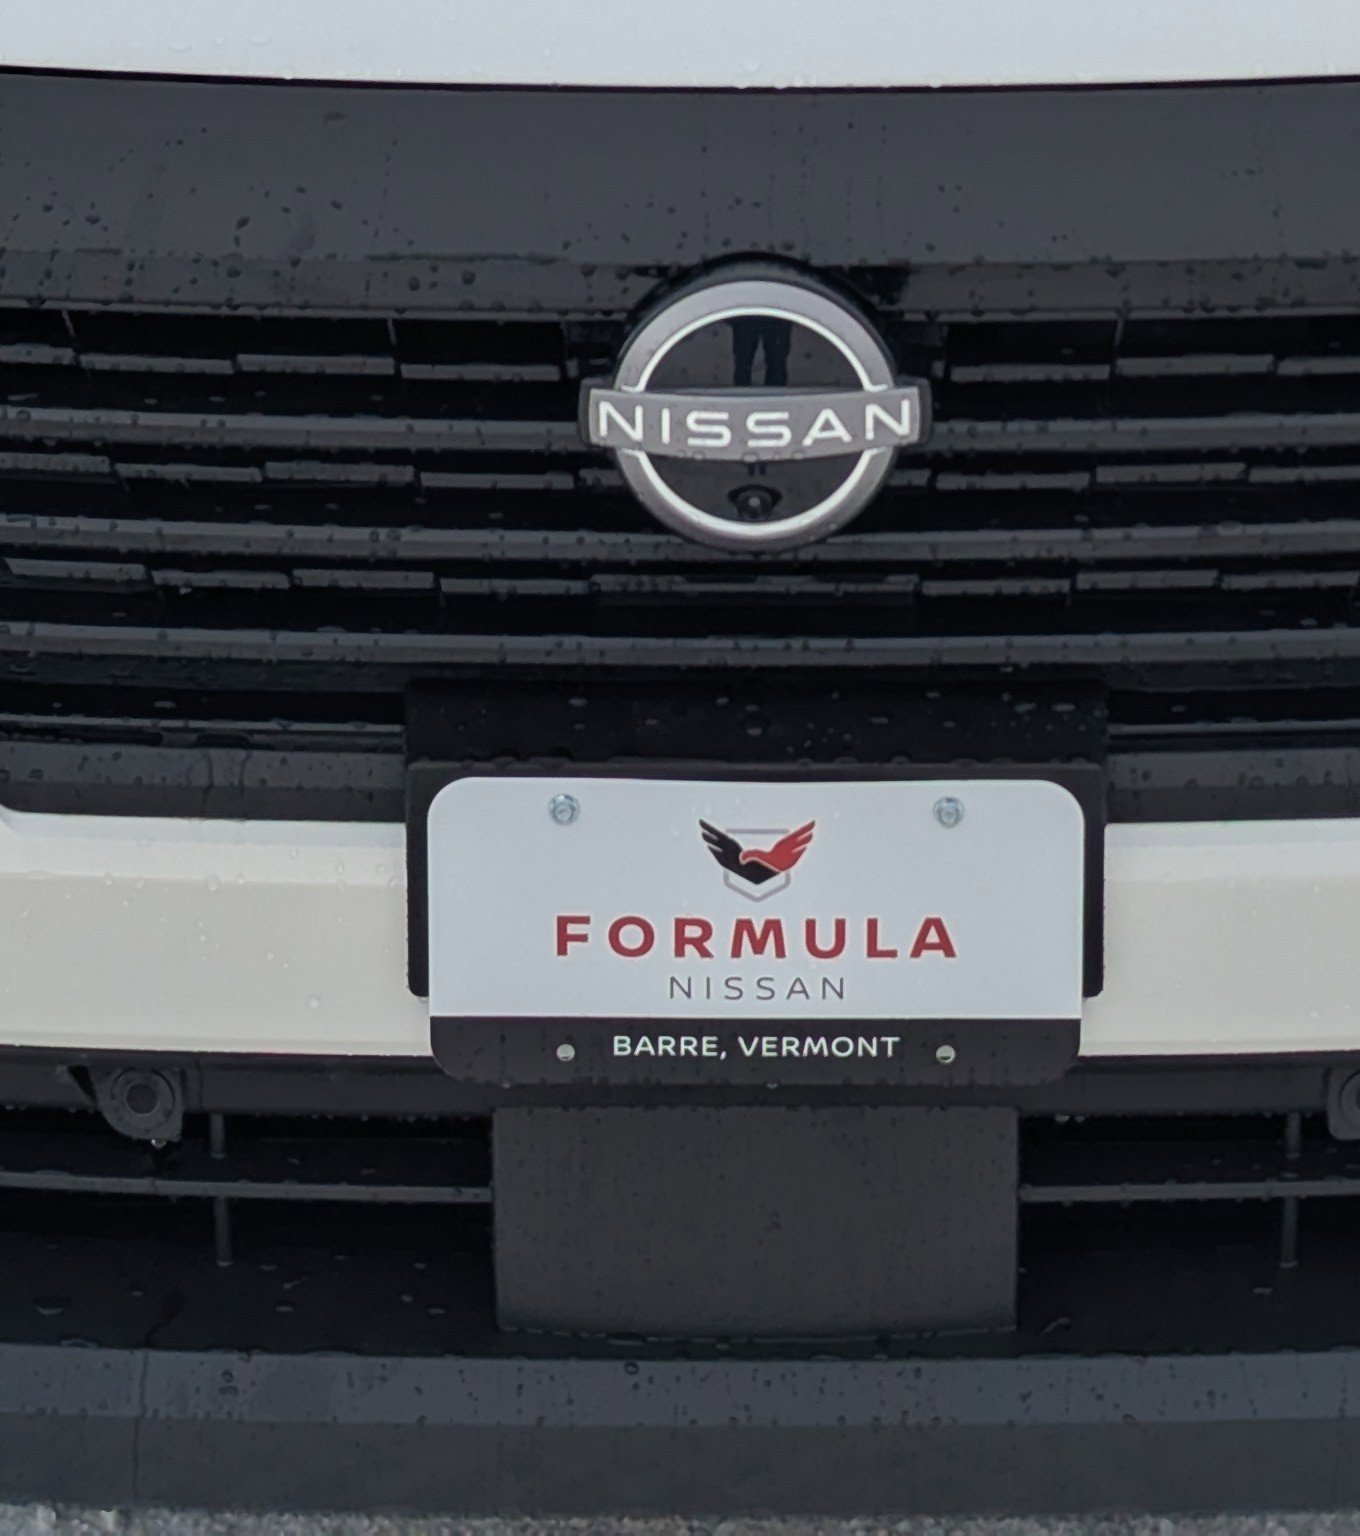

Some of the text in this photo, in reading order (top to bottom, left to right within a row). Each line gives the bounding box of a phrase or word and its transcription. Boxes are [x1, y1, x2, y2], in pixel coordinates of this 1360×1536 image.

[598, 399, 911, 448] NISSAN
[554, 914, 958, 959] FORMULA
[668, 975, 846, 1001] NISSAN
[612, 1035, 901, 1061] BARRE, VERMONT
